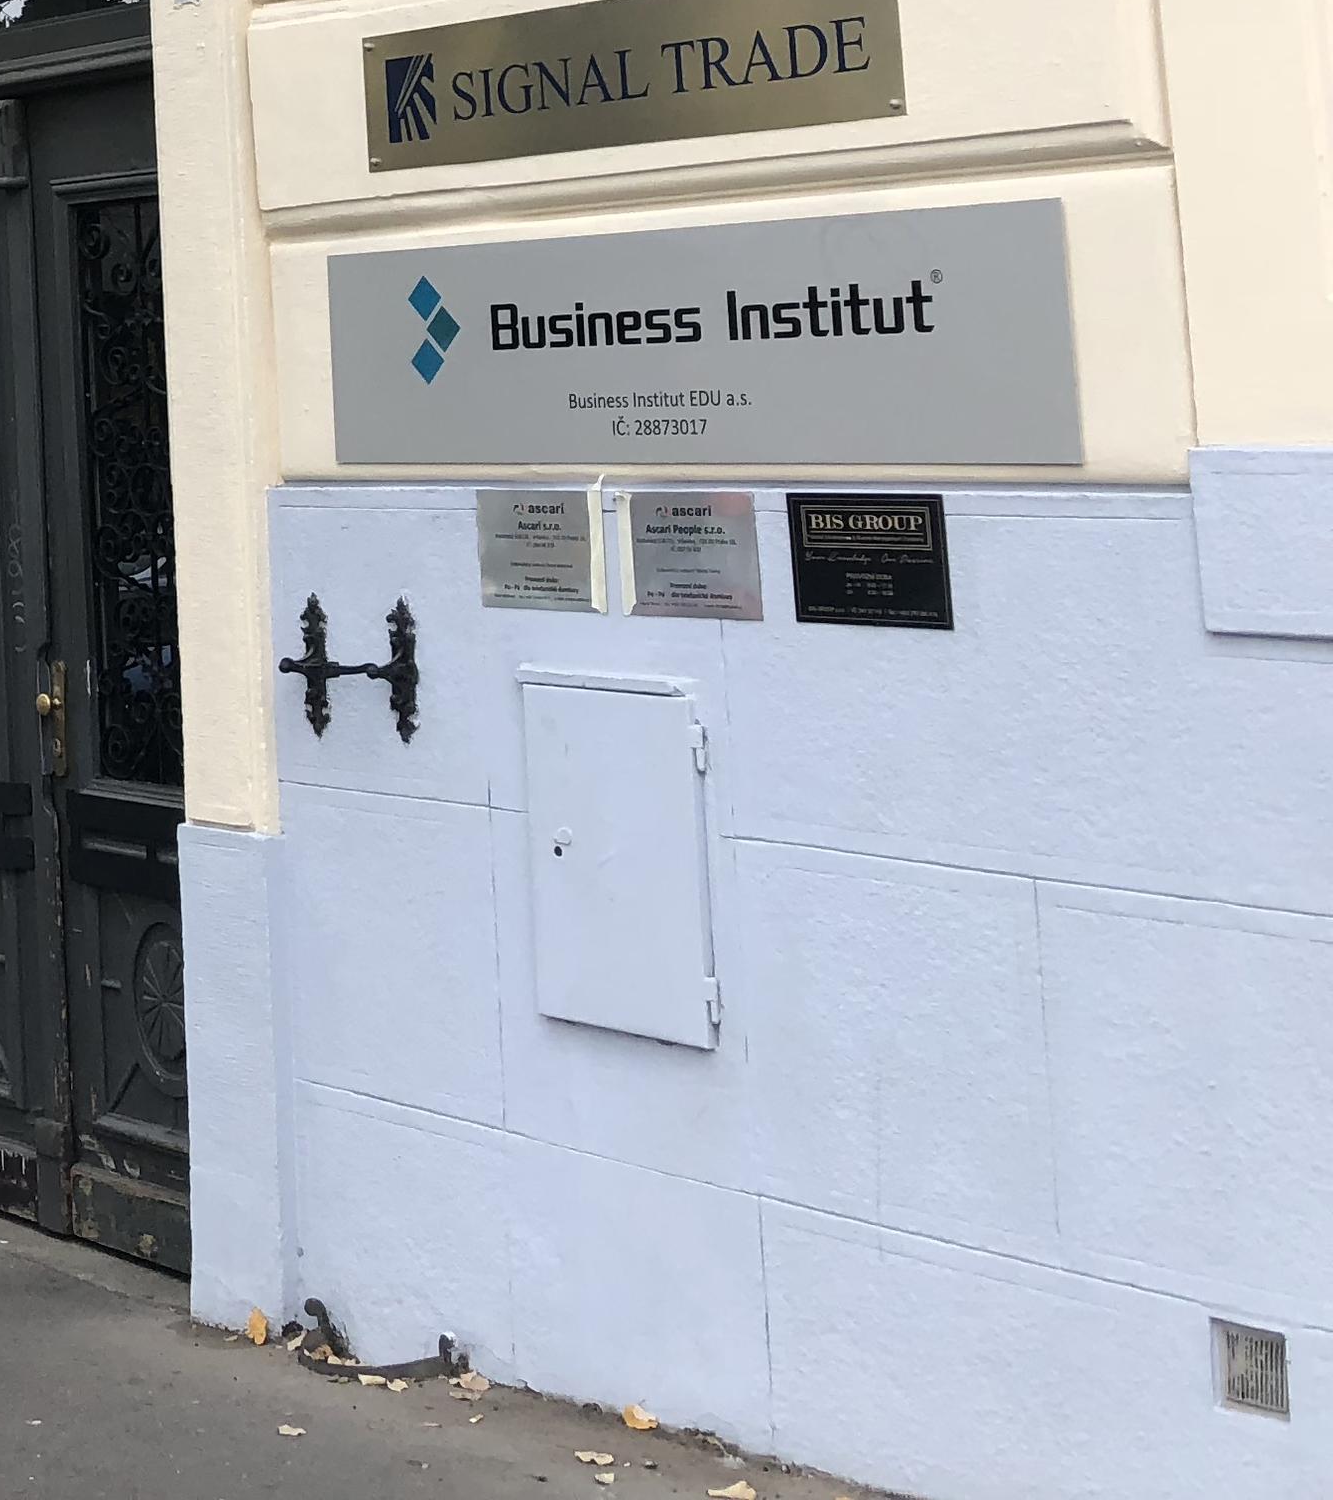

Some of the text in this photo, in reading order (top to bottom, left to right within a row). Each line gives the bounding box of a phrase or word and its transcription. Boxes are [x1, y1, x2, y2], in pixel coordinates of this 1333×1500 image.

[451, 16, 871, 121] SIGNAL TRADE
[489, 302, 702, 351] Business
[568, 390, 752, 409] Business Institut EDU a.s.
[612, 415, 708, 436] IČ: 28873017
[528, 503, 565, 514] ascari
[671, 505, 712, 517] ascari
[517, 521, 541, 531] Ascari
[645, 524, 726, 536] Ascari People s.r.o.
[808, 513, 923, 531] BIS GROUP
